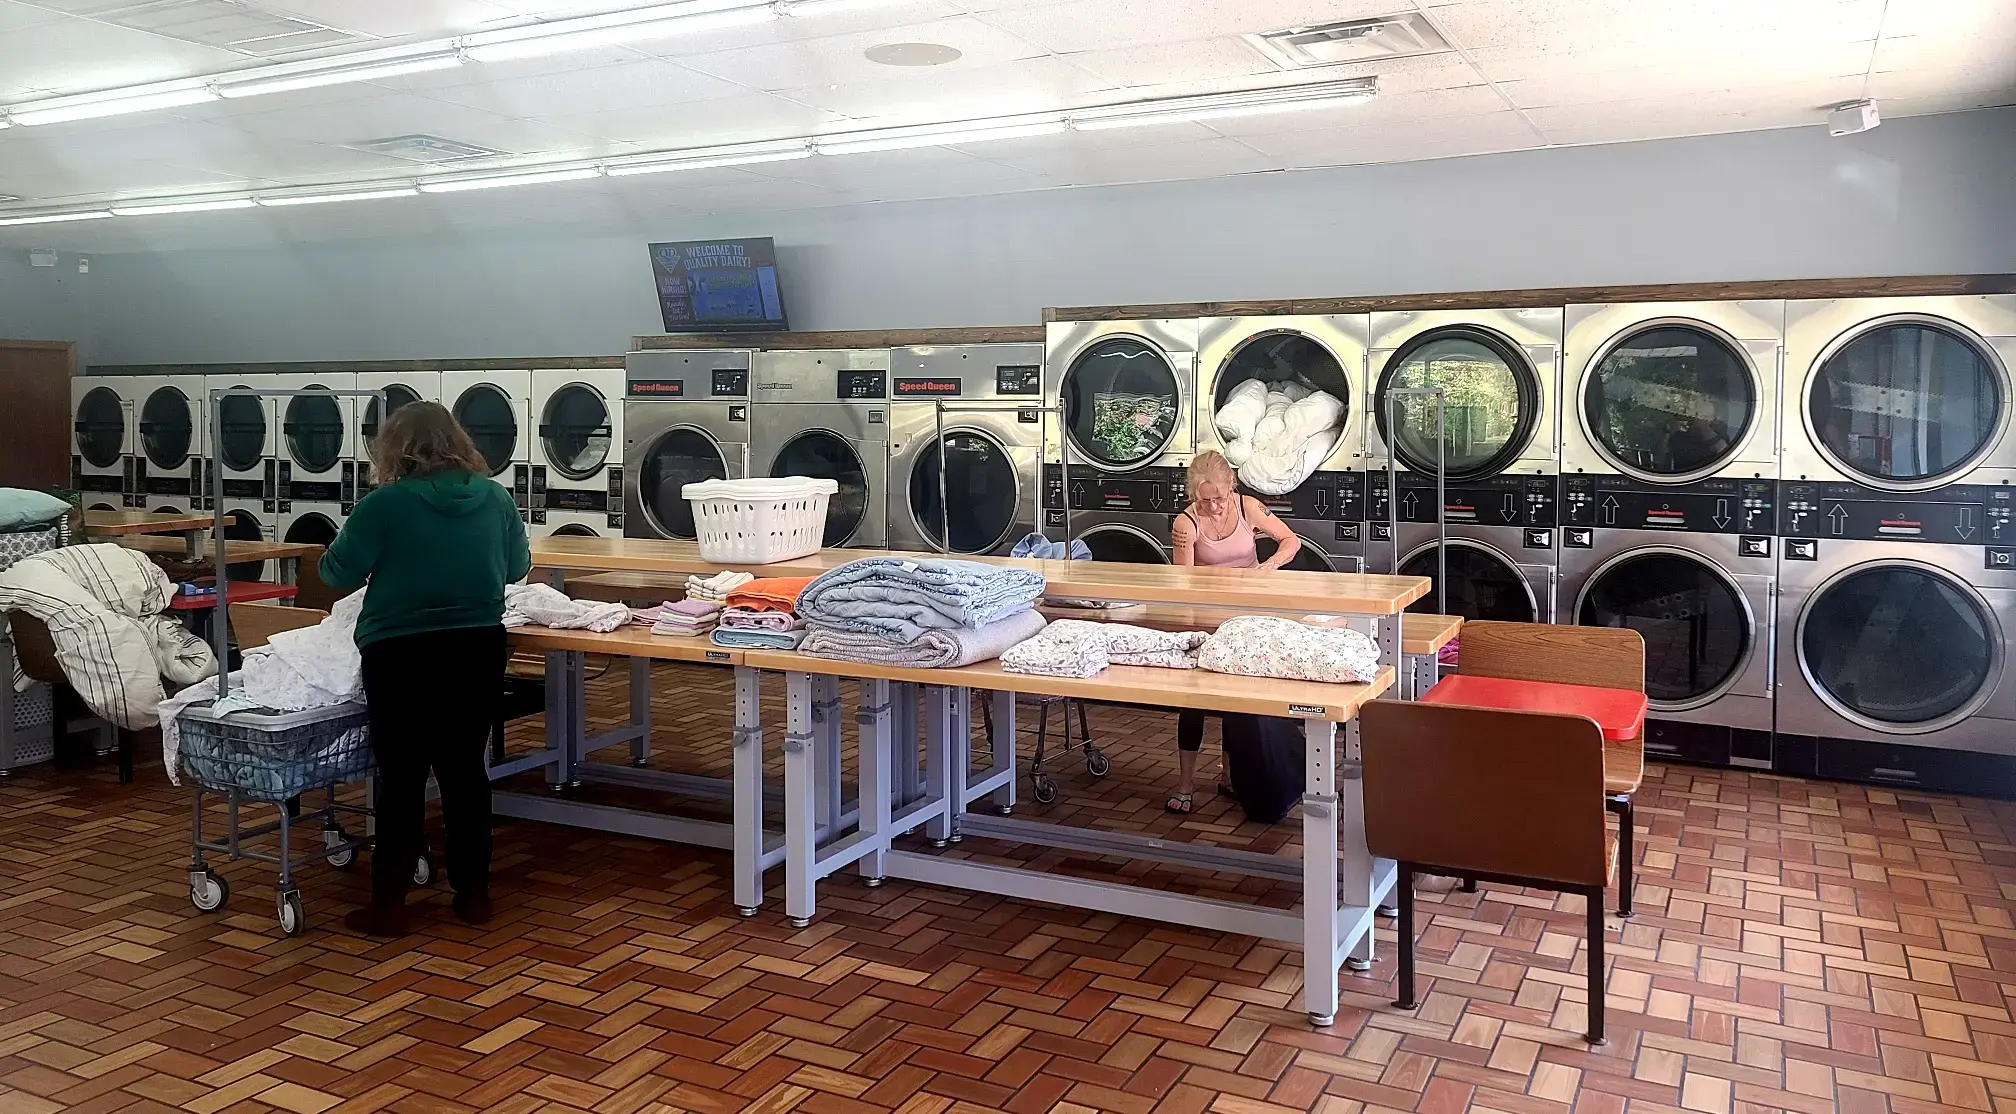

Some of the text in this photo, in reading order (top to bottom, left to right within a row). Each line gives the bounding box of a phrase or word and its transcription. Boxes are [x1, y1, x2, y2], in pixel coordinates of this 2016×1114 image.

[685, 244, 744, 258] WELCOME TO
[683, 256, 719, 270] QUALITY
[720, 255, 751, 268] DAIRY!
[664, 277, 680, 286] NOW
[632, 383, 679, 392] Speed Queen
[899, 381, 956, 392] Speed Queen
